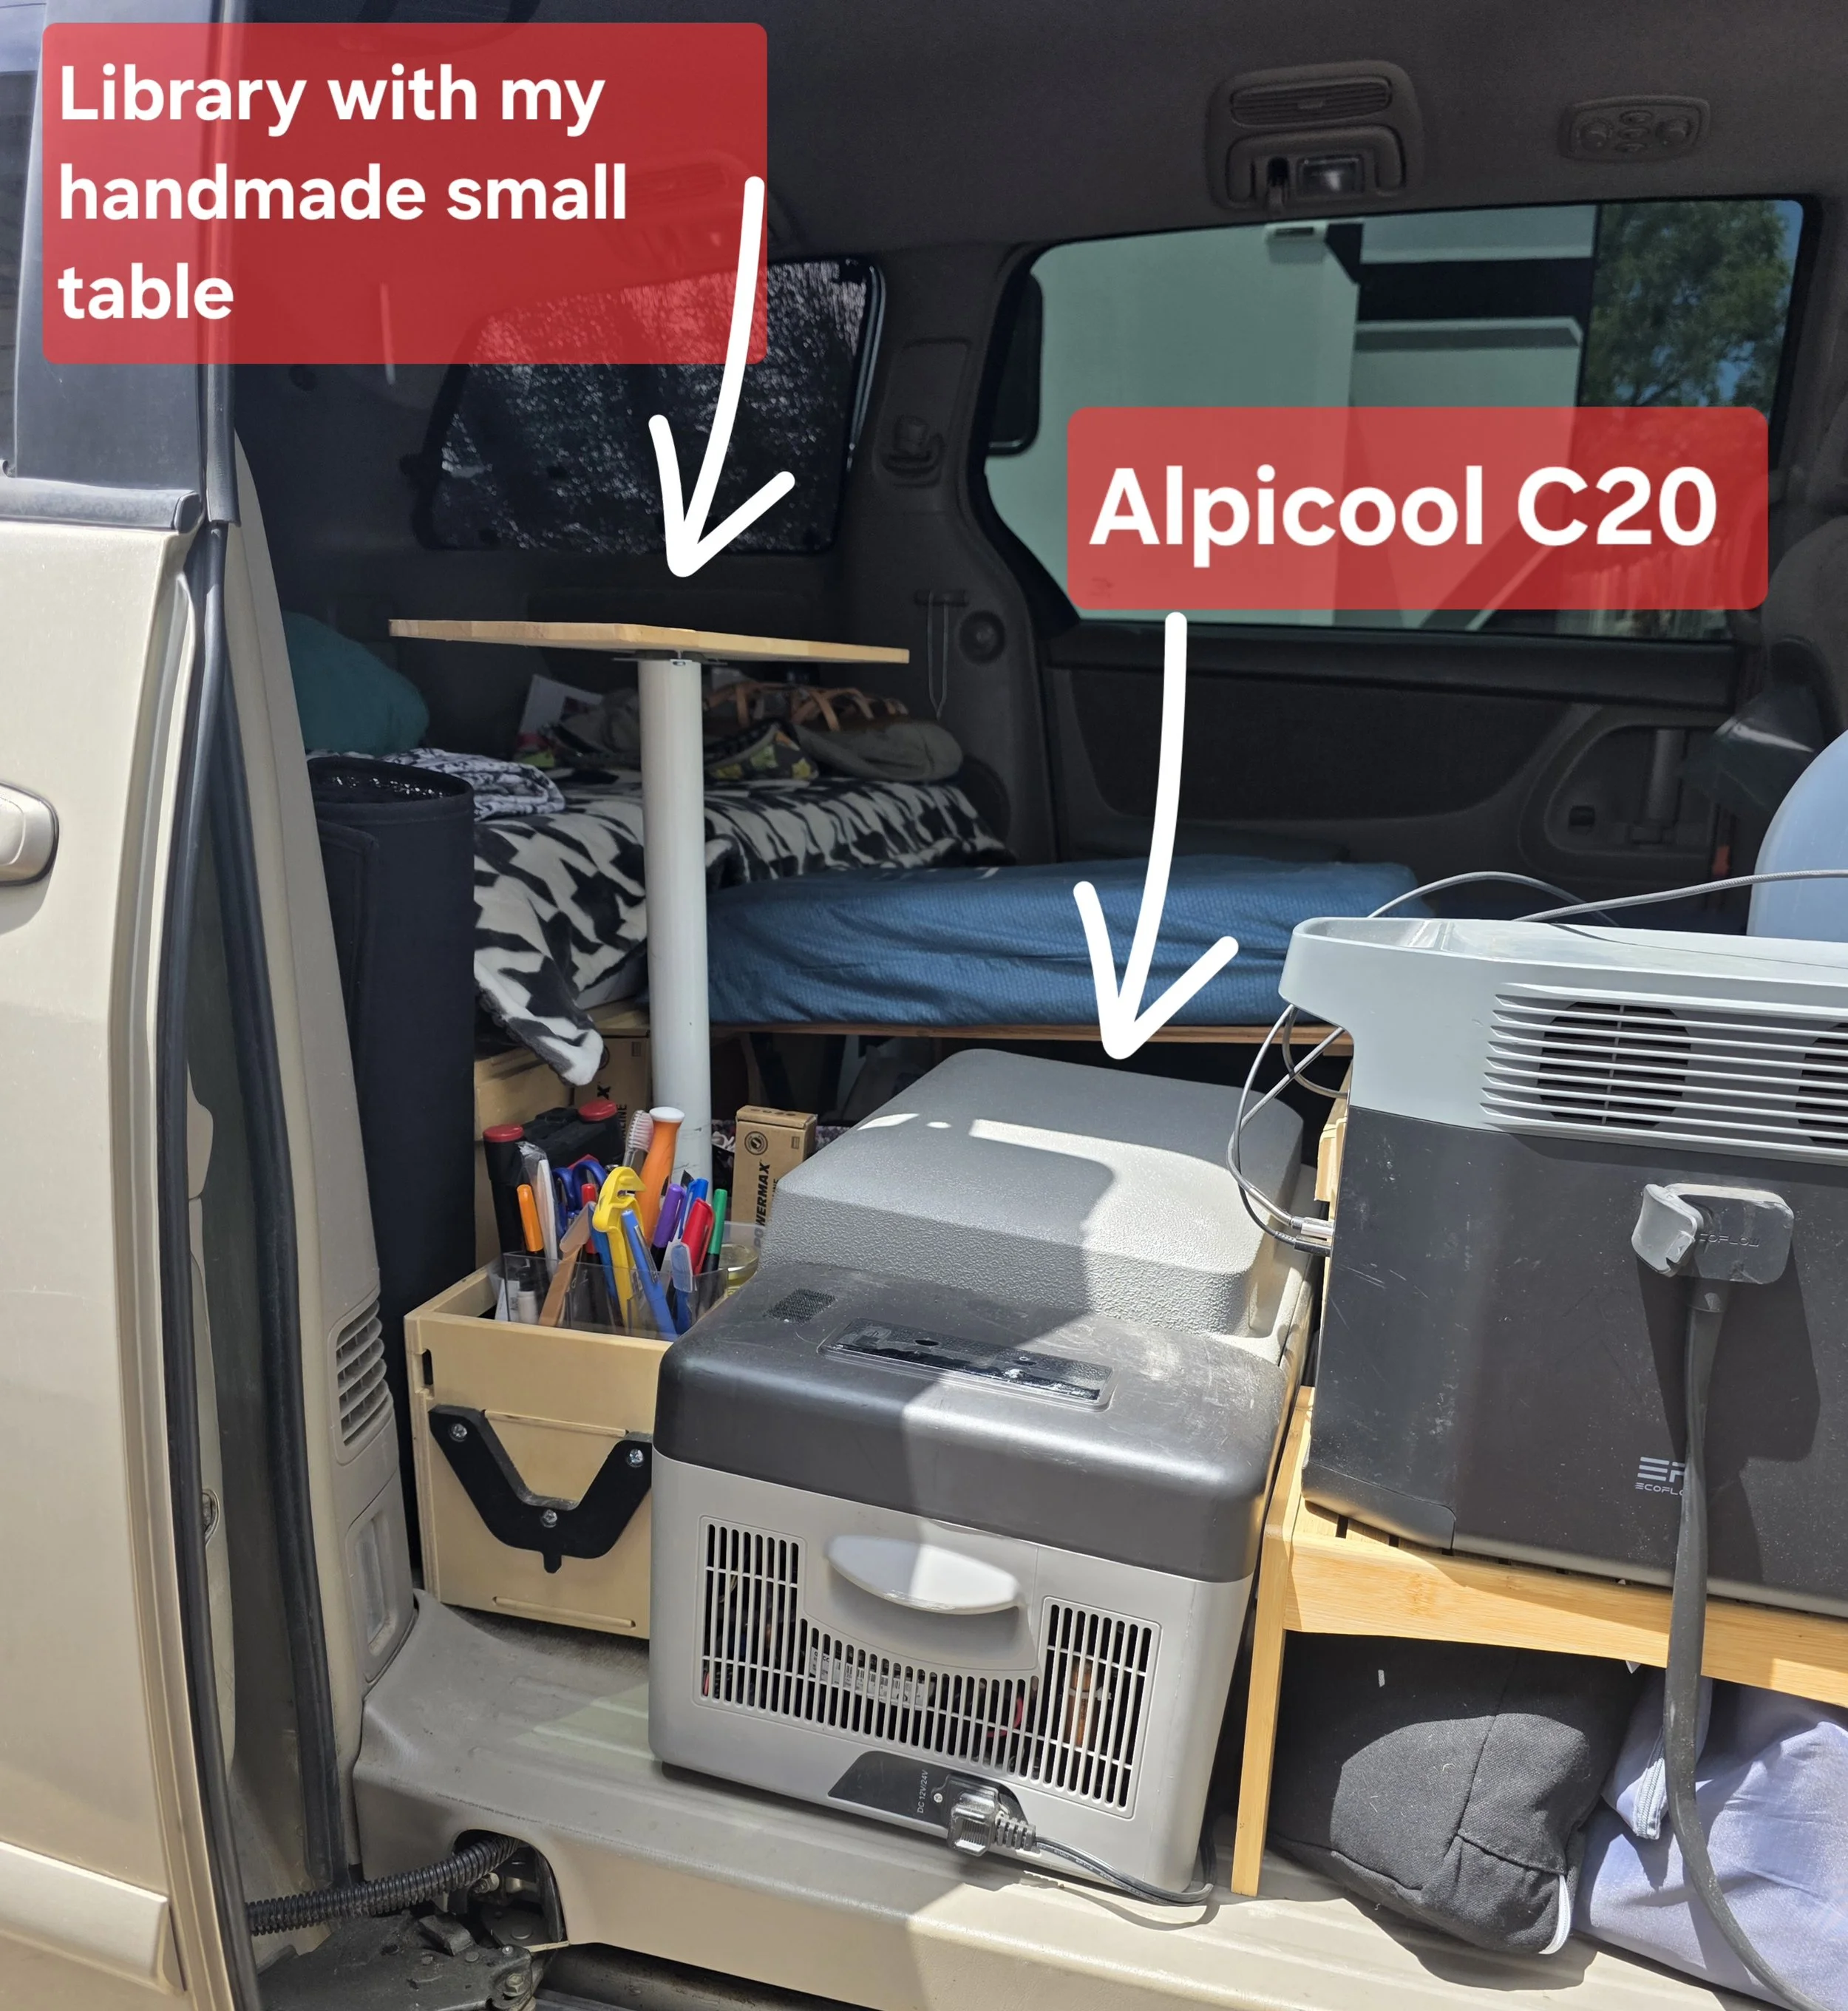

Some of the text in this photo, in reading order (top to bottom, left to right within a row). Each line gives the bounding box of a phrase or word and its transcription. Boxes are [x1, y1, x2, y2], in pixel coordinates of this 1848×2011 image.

[754, 1162, 770, 1249] POWERMAX
[1698, 1232, 1761, 1247] COFLOW
[1634, 1482, 1684, 1496] ECOFL
[917, 1768, 928, 1814] DC 12V/24V
